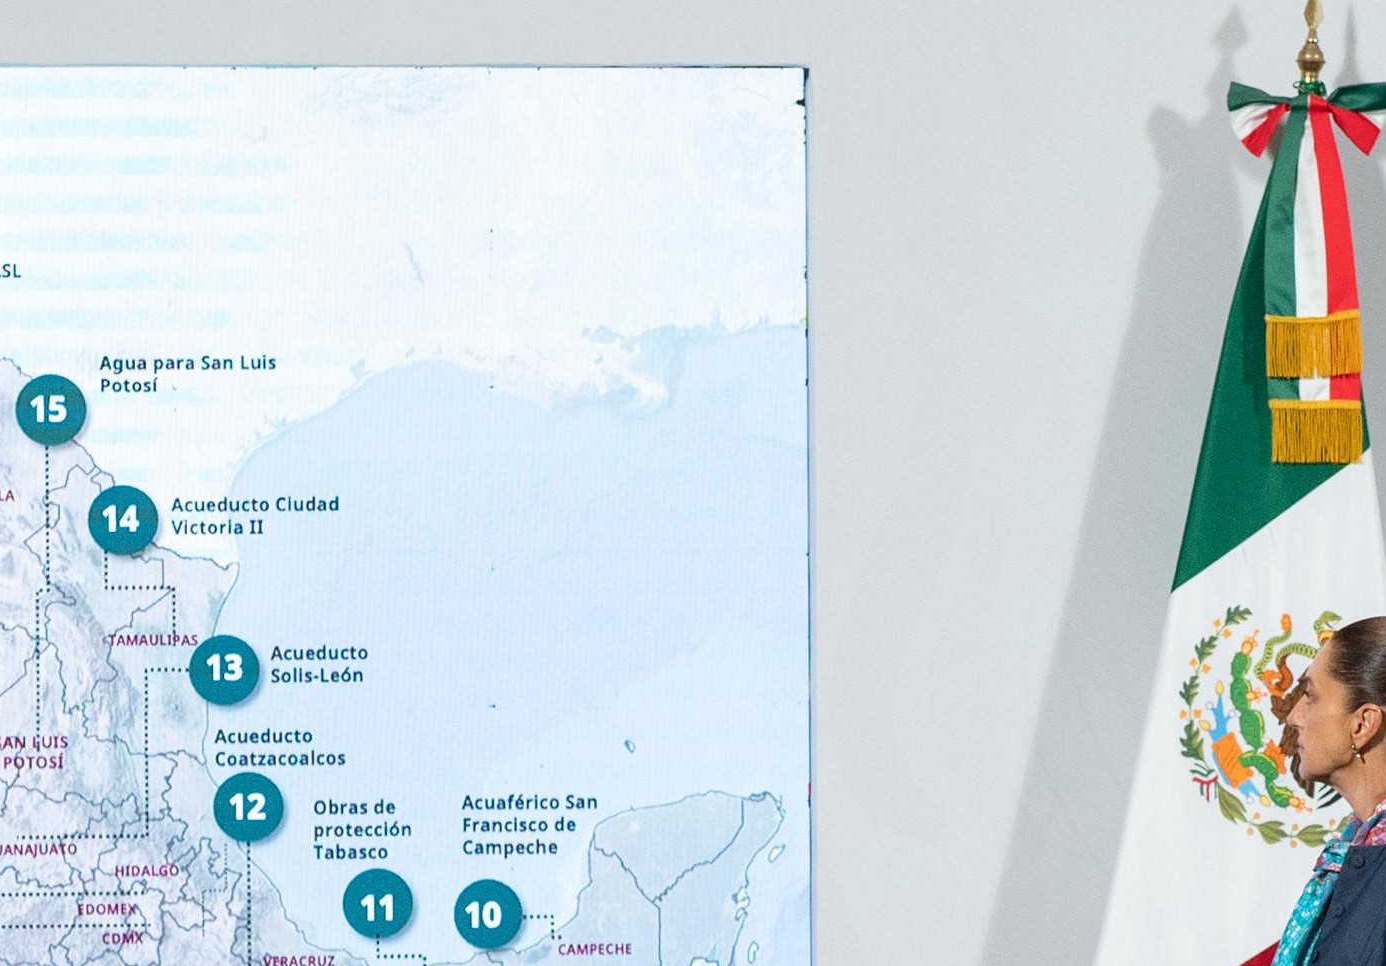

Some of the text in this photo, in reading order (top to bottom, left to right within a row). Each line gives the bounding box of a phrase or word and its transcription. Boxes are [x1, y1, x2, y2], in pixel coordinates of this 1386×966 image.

[100, 353, 276, 374] Agua para San Luis
[100, 376, 158, 393] Potosí
[30, 394, 67, 422] 15
[171, 494, 340, 514] Acueducto Ciudad
[102, 504, 140, 532] 14
[171, 518, 264, 536] Victoria II
[109, 634, 198, 647] TAMAULIPAS
[271, 646, 368, 661] Acueducto
[206, 654, 244, 682] 13
[32, 736, 68, 749] LUIS
[215, 729, 313, 744] Acueducto
[4, 755, 64, 769] POTOSÍ
[215, 750, 346, 767] Coatzacoalcos
[229, 793, 266, 821] 12
[314, 799, 396, 815] Obras de
[462, 794, 597, 811] Acuaférico San
[314, 821, 412, 841] protección
[463, 817, 576, 833] Francisco de
[315, 844, 388, 860] Tabasco
[463, 839, 558, 859] Campeche
[115, 865, 179, 877] HIDALGO
[78, 904, 137, 915] EDOMEX
[360, 893, 395, 922] 11
[465, 901, 501, 929] 10
[102, 932, 143, 944] CDMX
[558, 942, 633, 957] CAMPECHE
